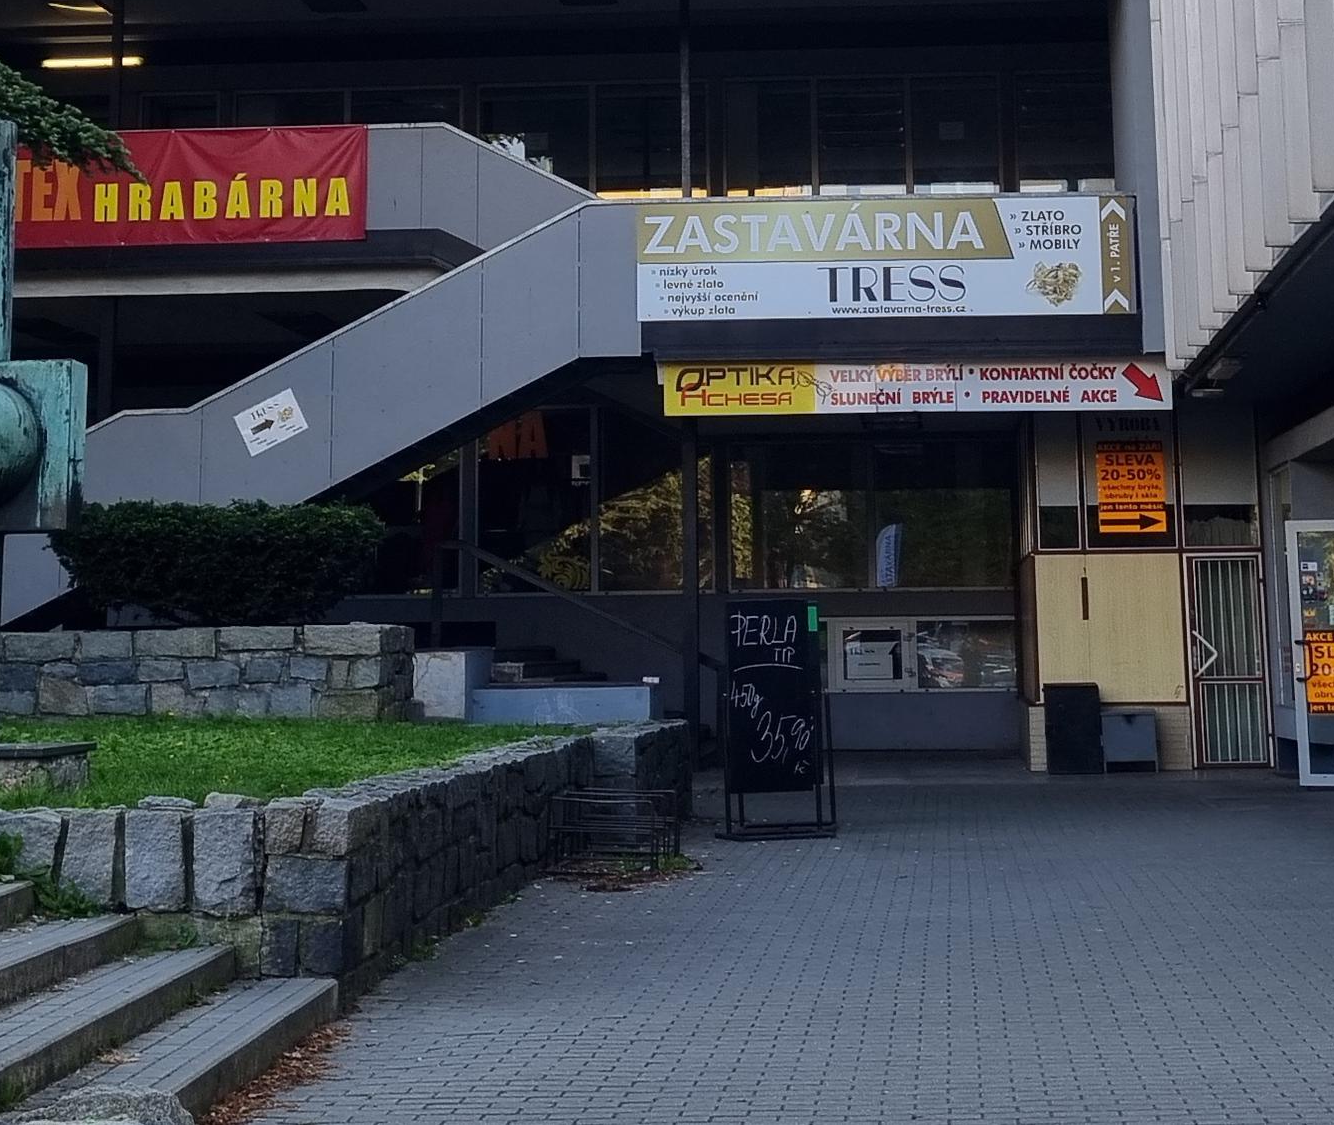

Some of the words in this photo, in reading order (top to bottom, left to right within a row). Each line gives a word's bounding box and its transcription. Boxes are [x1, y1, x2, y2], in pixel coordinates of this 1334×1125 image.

[93, 172, 351, 222] HRABÁRNA
[1021, 210, 1065, 222] ZLATO
[643, 203, 985, 255] ZASTAVÁRNA
[1026, 221, 1082, 236] STŘÍBRO
[1030, 238, 1081, 250] MOBILY
[1107, 223, 1120, 258] PATŘE
[659, 266, 688, 279] nízký
[691, 265, 717, 276] úrok
[663, 278, 694, 289] levné
[697, 279, 724, 289] zlato
[817, 264, 967, 303] TRESS
[667, 292, 711, 304] nejvyšší
[671, 304, 705, 316] výkup
[708, 305, 736, 315] zlata
[676, 366, 795, 393] OPTIKA
[830, 364, 875, 384] VELKÝ
[875, 363, 922, 383] VÝBĚR
[925, 362, 964, 381] BRÝLÍ
[979, 362, 1066, 381] KONTAKTNÍ
[1068, 362, 1117, 381] ČOČKY
[830, 388, 902, 406] SLUNEČNÍ
[913, 386, 954, 404] BRÝLE
[981, 385, 1070, 404] PRAVIDELNÉ
[1080, 388, 1117, 403] AKCE
[1105, 454, 1156, 466] SLEVA
[1100, 468, 1162, 481] 20-50%
[730, 611, 797, 647] PERLA
[1305, 632, 1333, 642] AKCE
[731, 680, 764, 719] 450g
[1310, 702, 1325, 713] jen
